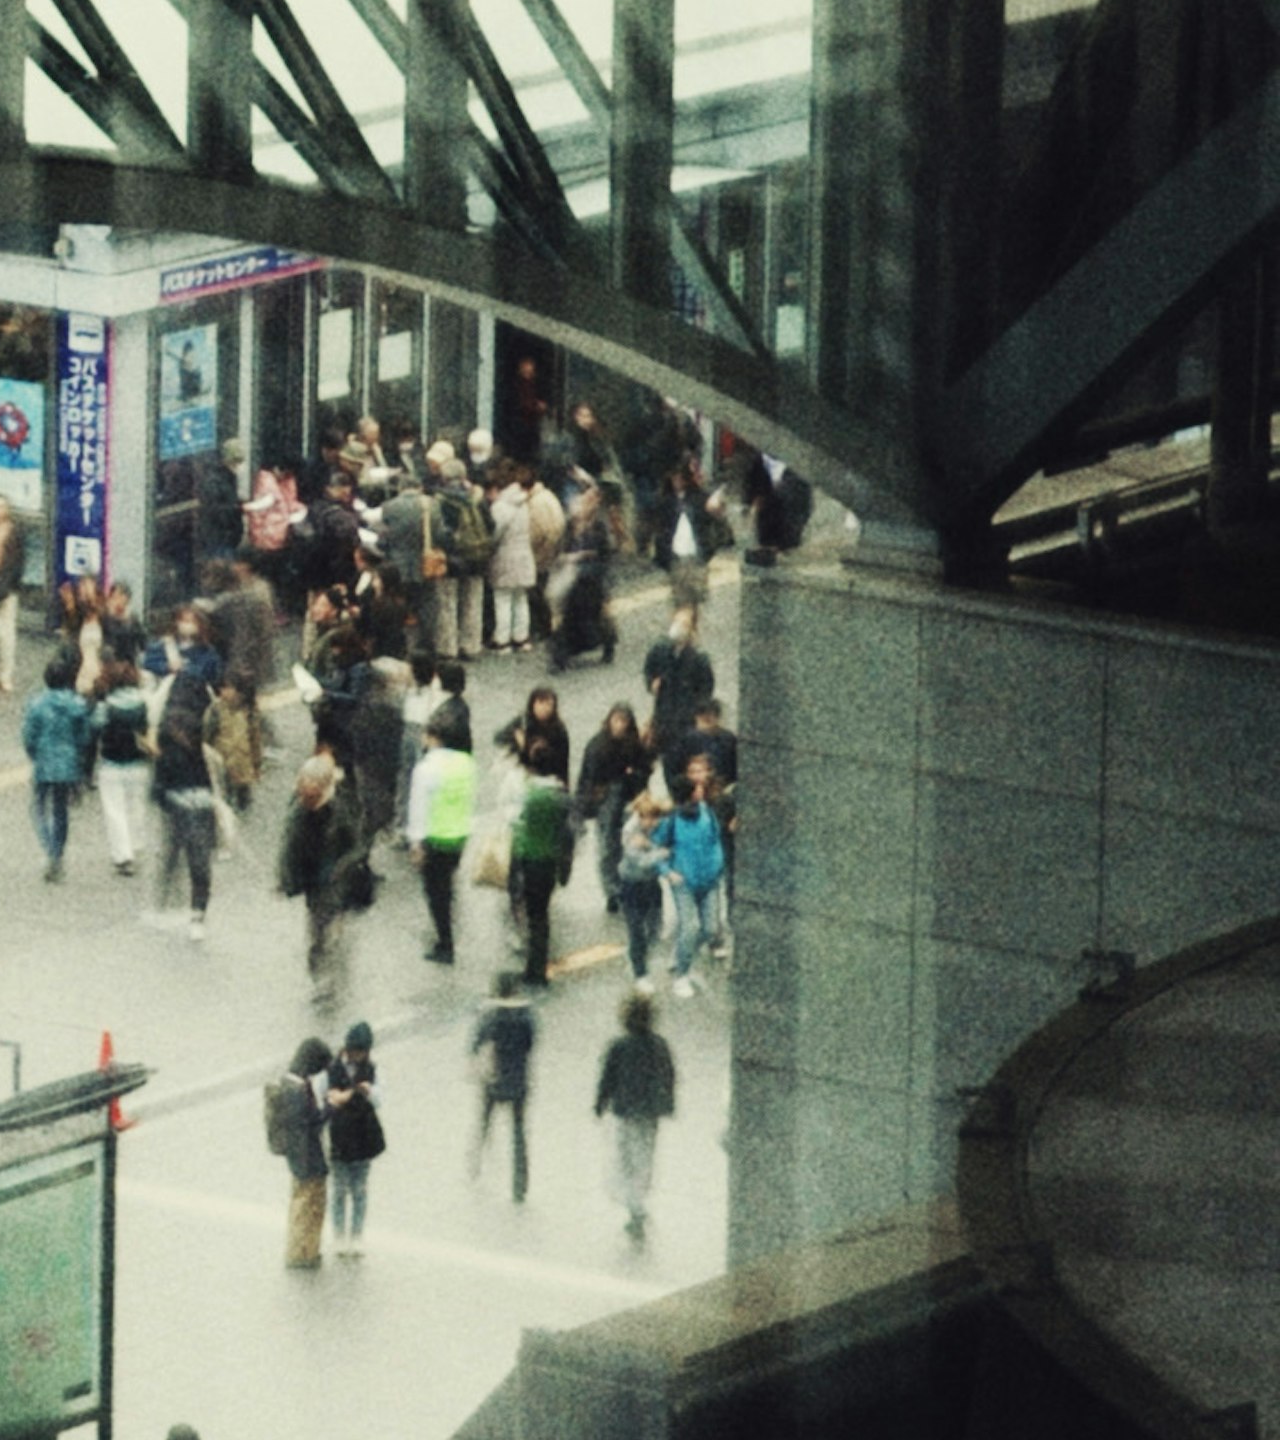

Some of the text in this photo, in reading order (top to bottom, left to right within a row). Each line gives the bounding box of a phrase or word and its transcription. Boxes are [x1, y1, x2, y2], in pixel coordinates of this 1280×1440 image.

[68, 357, 81, 473] コインロッカー
[79, 357, 98, 527] バスチケットセンター
